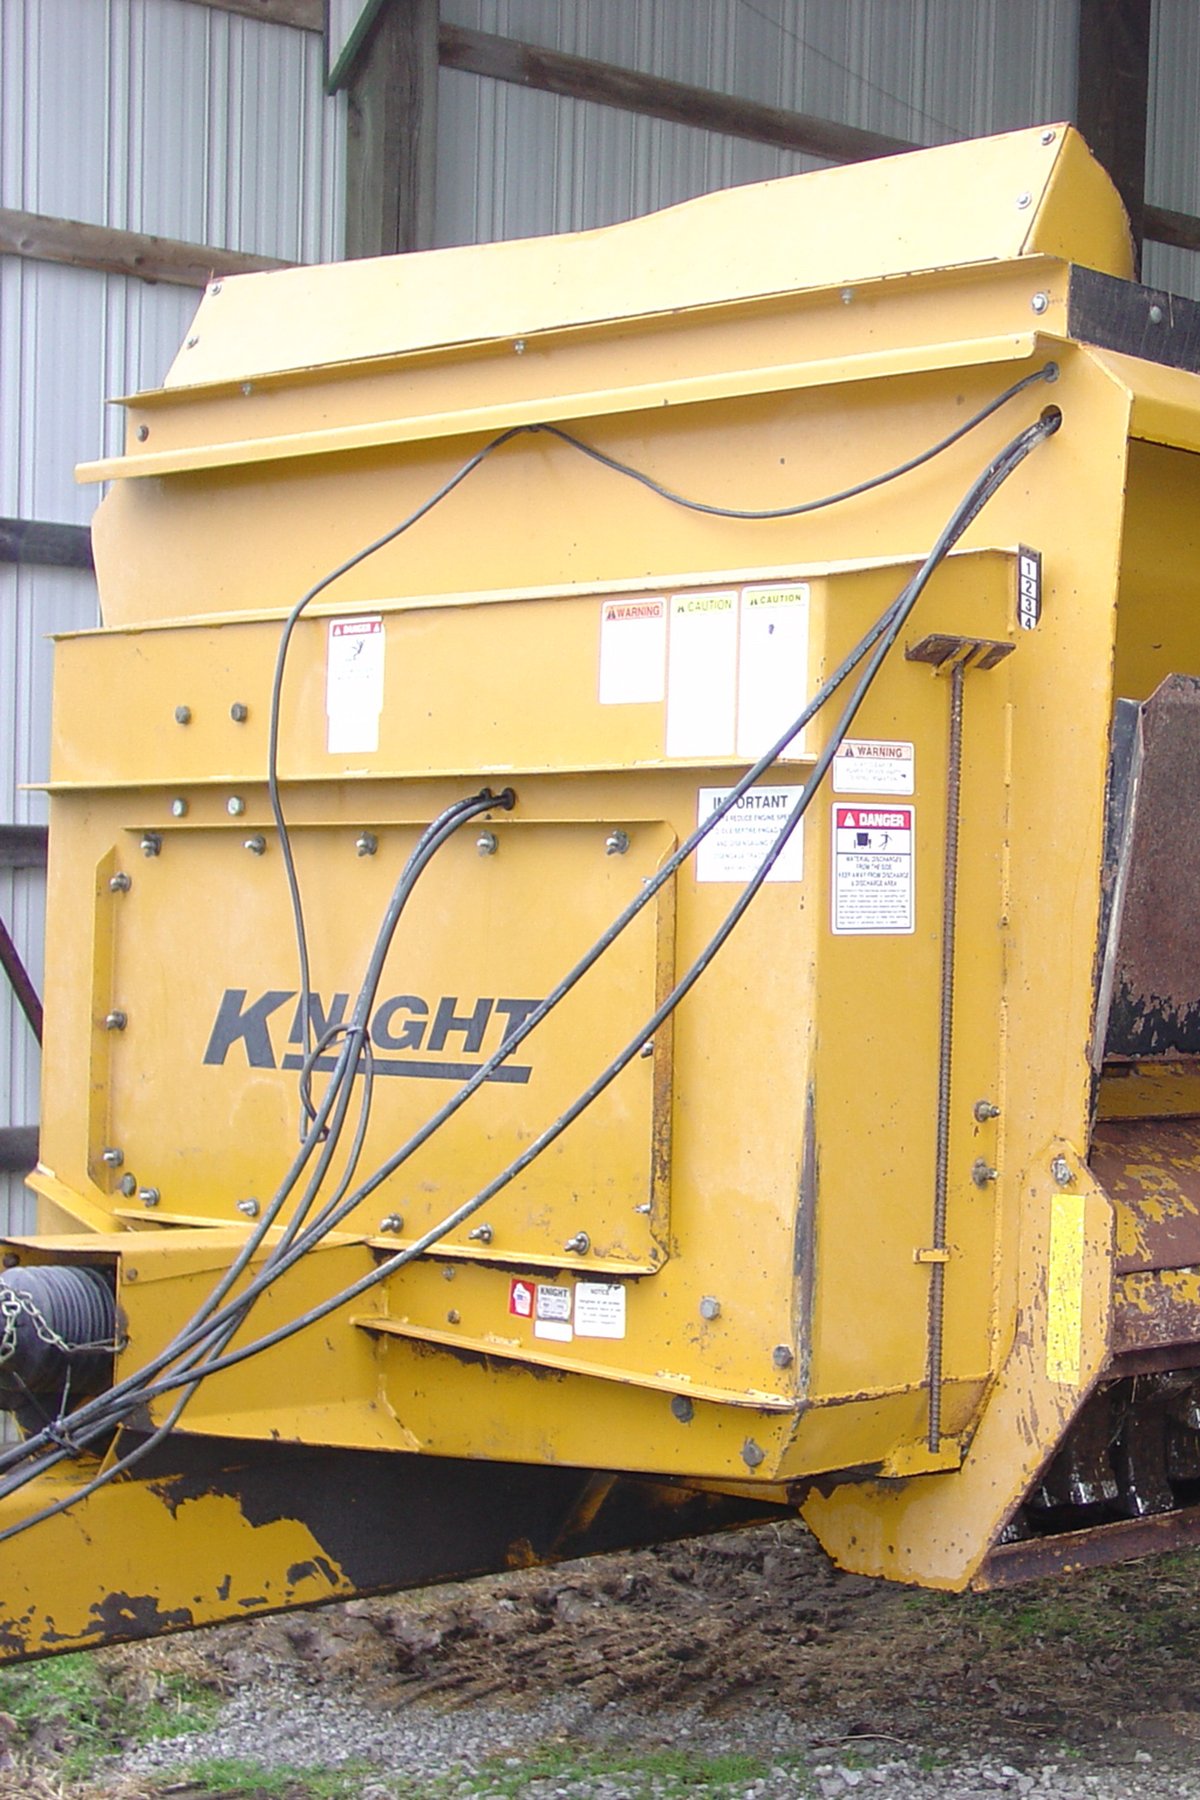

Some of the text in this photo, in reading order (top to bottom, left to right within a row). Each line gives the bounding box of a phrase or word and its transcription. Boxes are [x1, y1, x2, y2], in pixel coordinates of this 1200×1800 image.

[1026, 562, 1031, 575] 1
[1025, 580, 1032, 594] 2
[687, 599, 733, 613] CAUTION
[759, 593, 802, 605] CAUTION
[1025, 598, 1032, 612] 3
[616, 604, 661, 619] WARNING
[1025, 617, 1031, 630] 4
[857, 746, 903, 758] WARNING
[713, 794, 789, 810] IORTANT
[858, 813, 905, 828] DANGER
[202, 988, 546, 1069] KNGHT
[540, 1287, 568, 1298] KNIGHT
